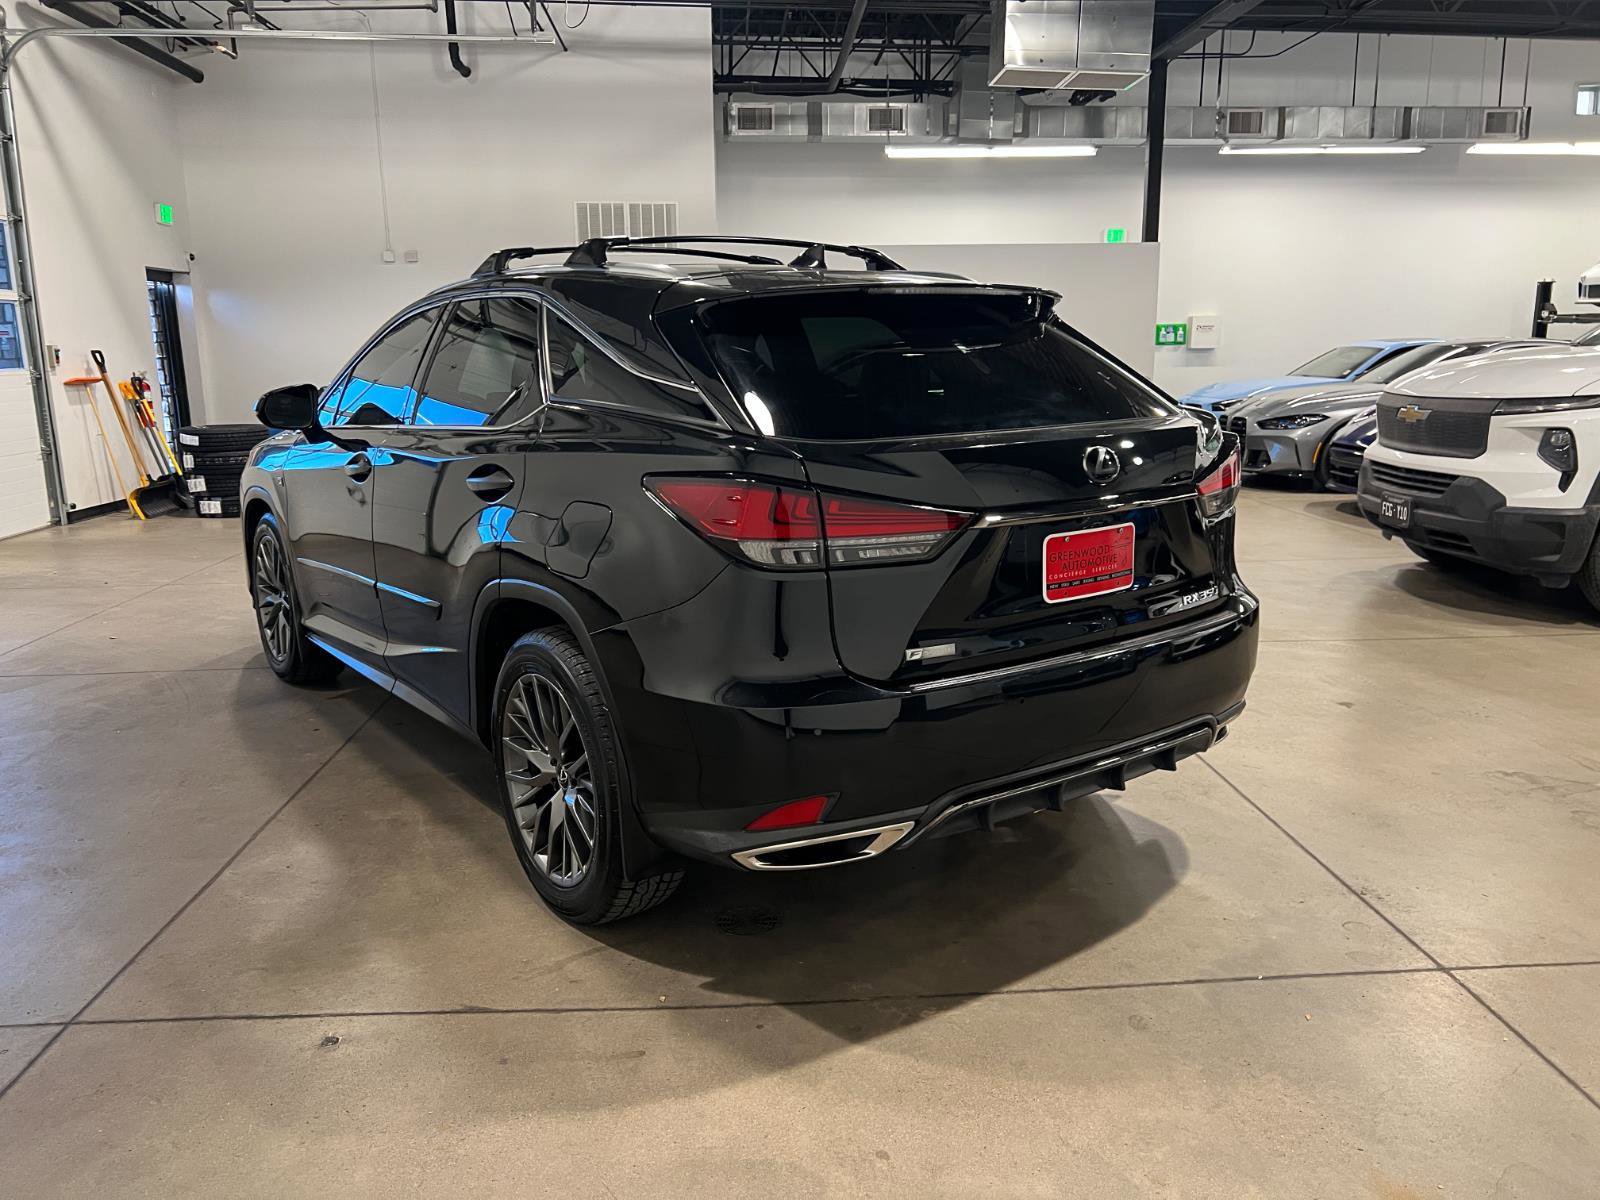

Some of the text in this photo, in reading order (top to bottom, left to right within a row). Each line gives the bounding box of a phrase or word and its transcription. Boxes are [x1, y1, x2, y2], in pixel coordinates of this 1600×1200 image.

[1049, 544, 1110, 563] GREENWOOD
[1062, 553, 1118, 571] AUTOMOTIVE
[1048, 569, 1086, 580] CONCIERGE
